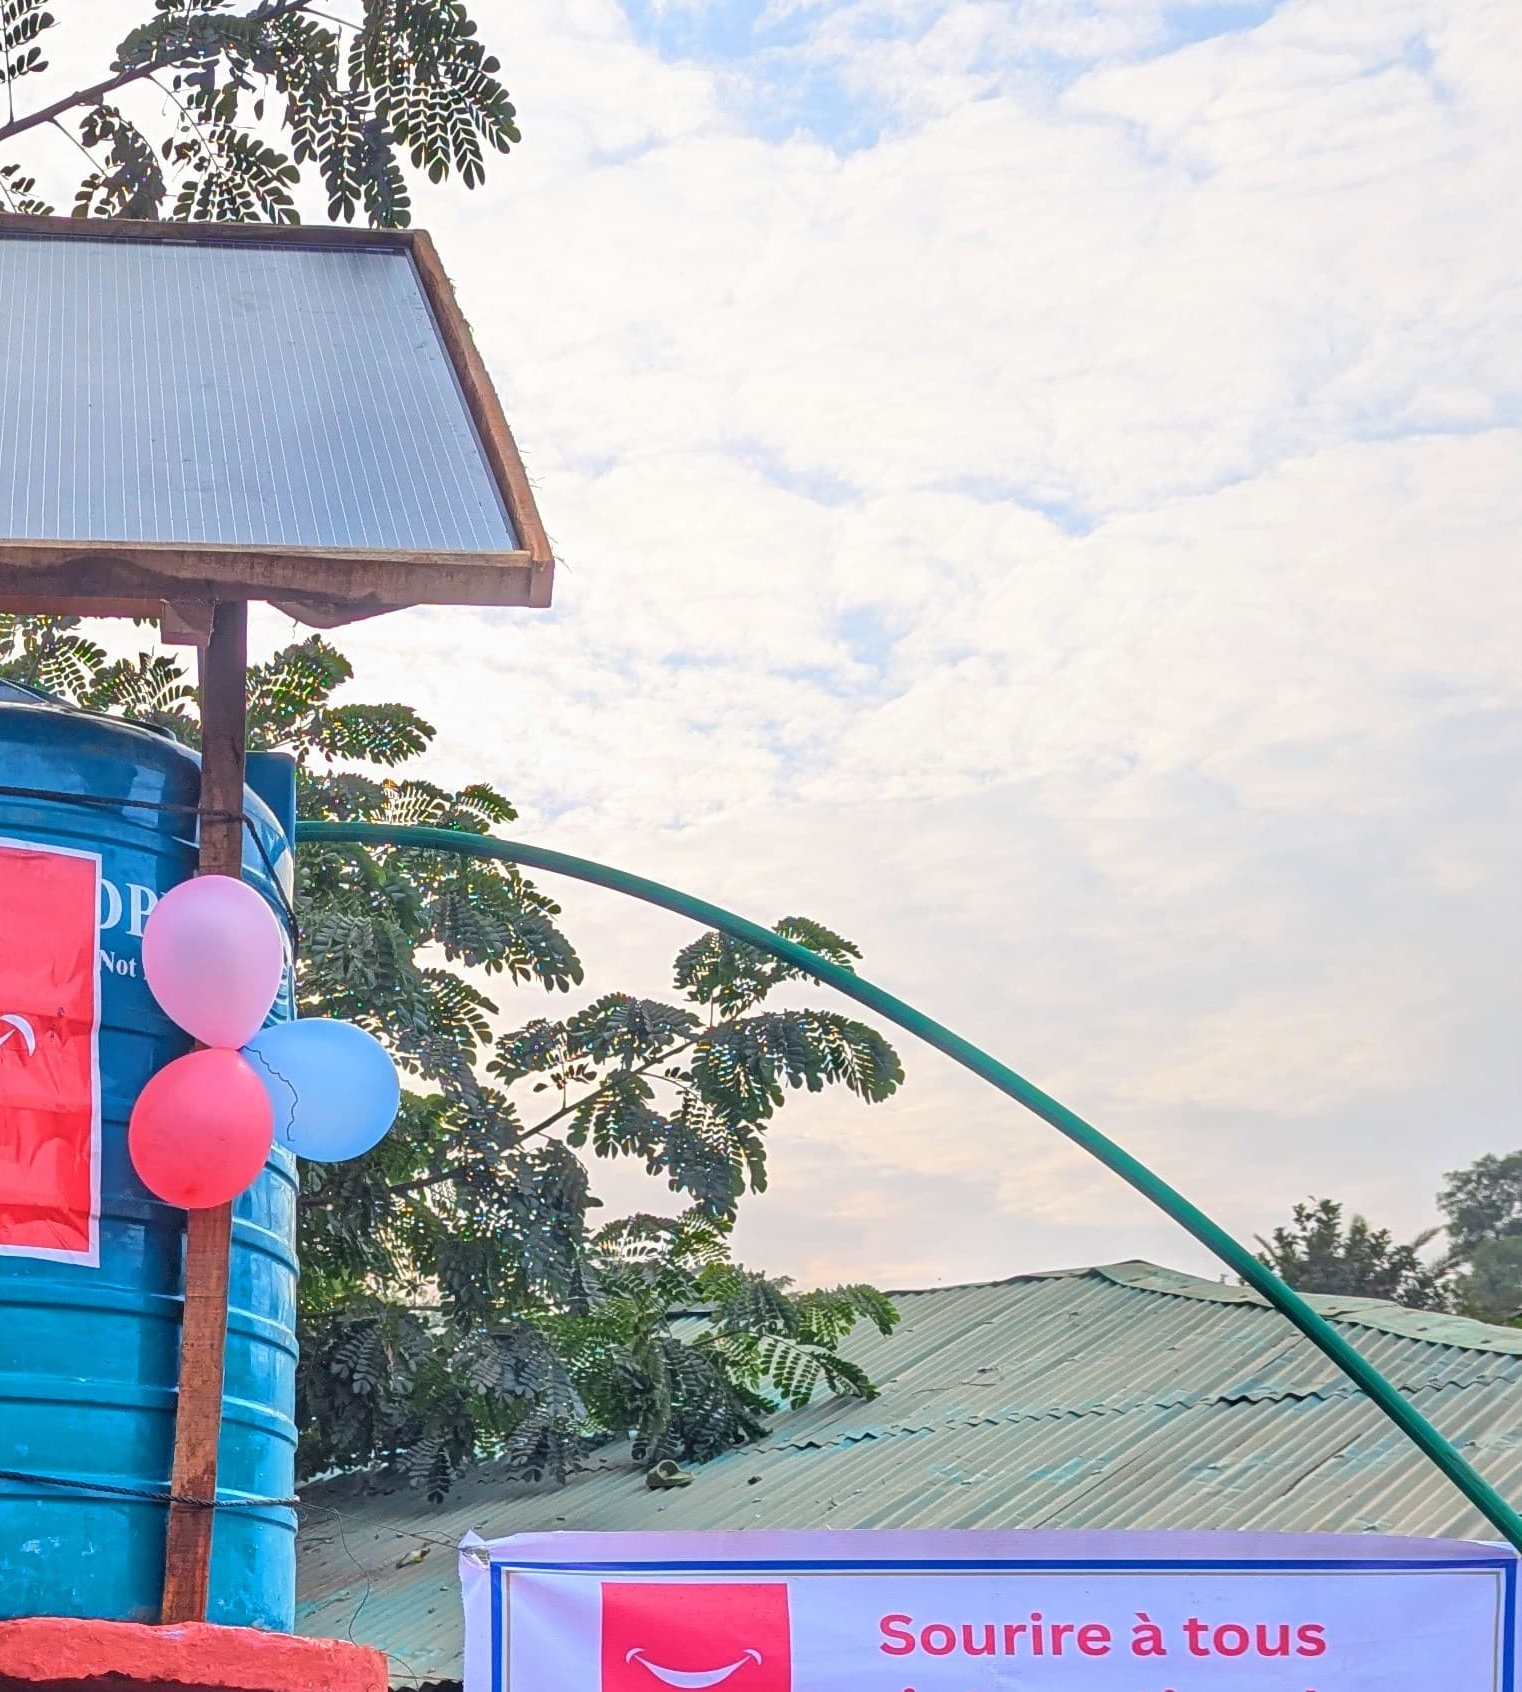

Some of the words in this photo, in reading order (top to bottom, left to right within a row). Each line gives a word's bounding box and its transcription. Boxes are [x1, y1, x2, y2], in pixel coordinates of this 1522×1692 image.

[98, 949, 138, 978] Not
[879, 1612, 1112, 1657] Sourire
[1131, 1612, 1167, 1657] à
[1182, 1617, 1327, 1657] tous
